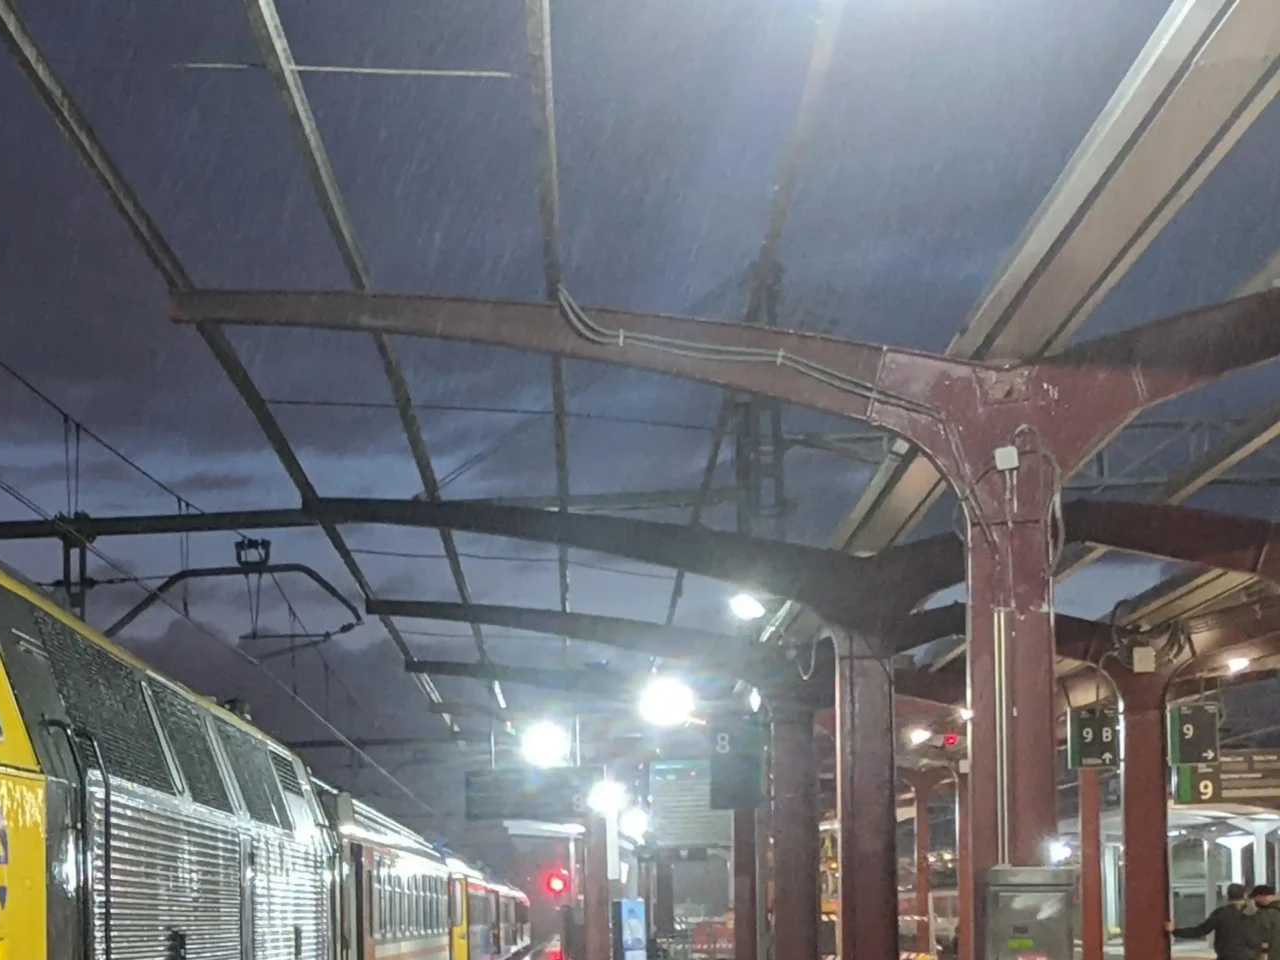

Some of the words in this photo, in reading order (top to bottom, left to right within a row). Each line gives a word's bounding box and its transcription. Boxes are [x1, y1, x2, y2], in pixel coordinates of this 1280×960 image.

[1082, 728, 1093, 742] 9
[1102, 727, 1112, 742] B
[1183, 724, 1194, 739] 9
[715, 733, 730, 754] 8
[1199, 780, 1213, 800] 9
